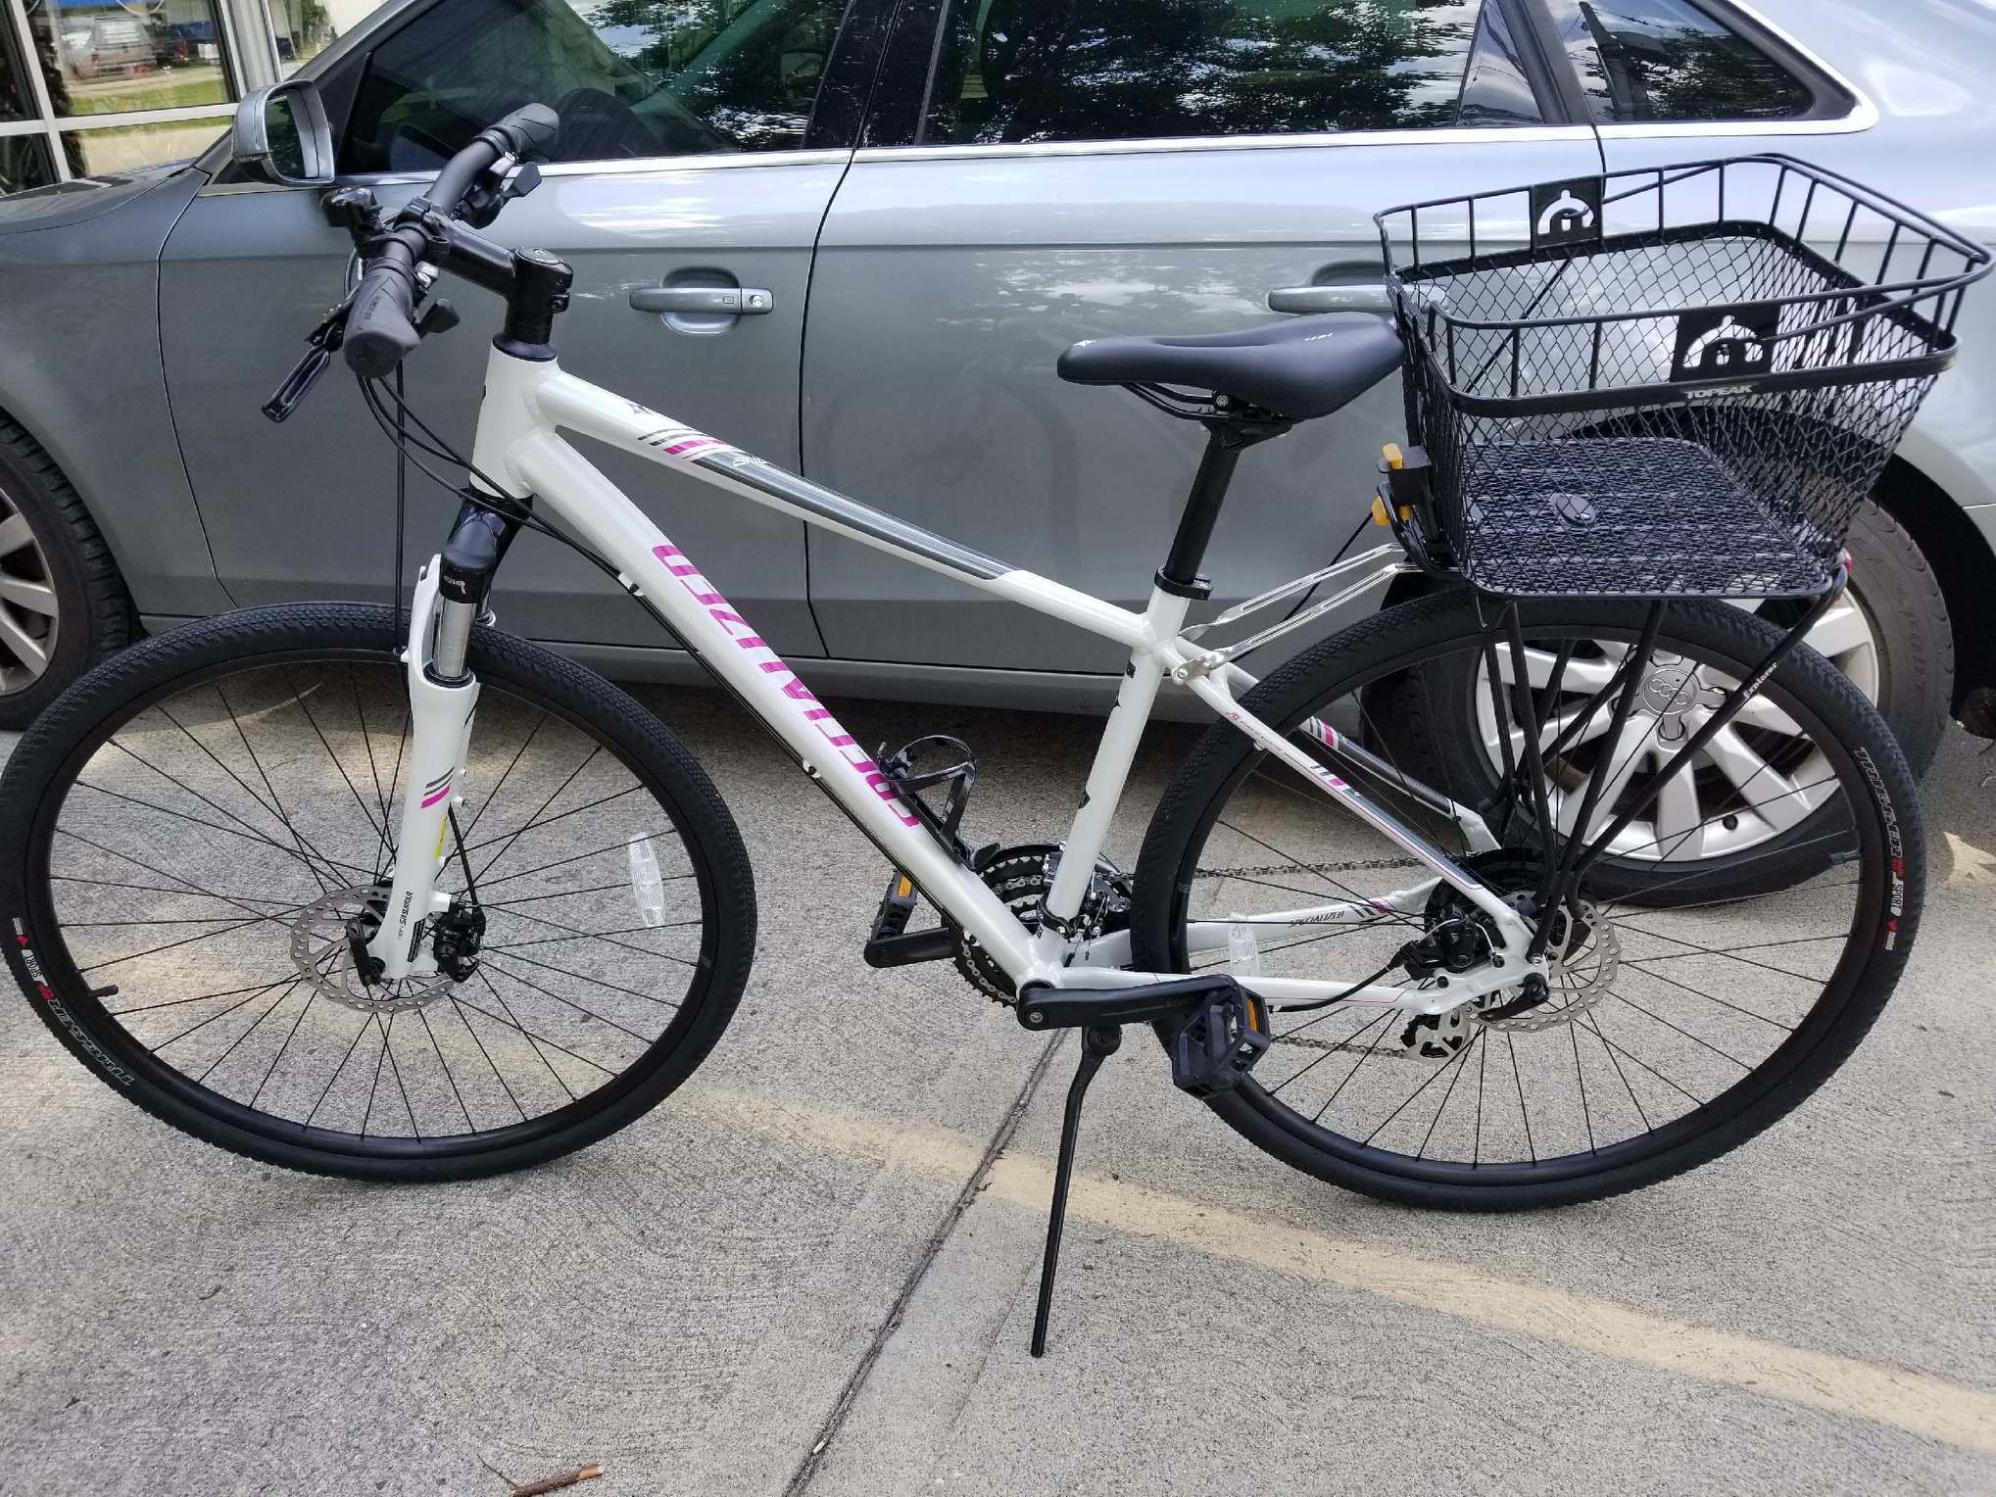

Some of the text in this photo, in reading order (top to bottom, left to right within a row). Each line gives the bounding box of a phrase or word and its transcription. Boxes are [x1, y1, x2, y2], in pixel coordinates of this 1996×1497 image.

[1684, 385, 1752, 399] TOPEAK
[652, 544, 920, 827] SPECIALIZED
[1743, 662, 1777, 699] Explorer
[1892, 883, 1904, 908] SPORT
